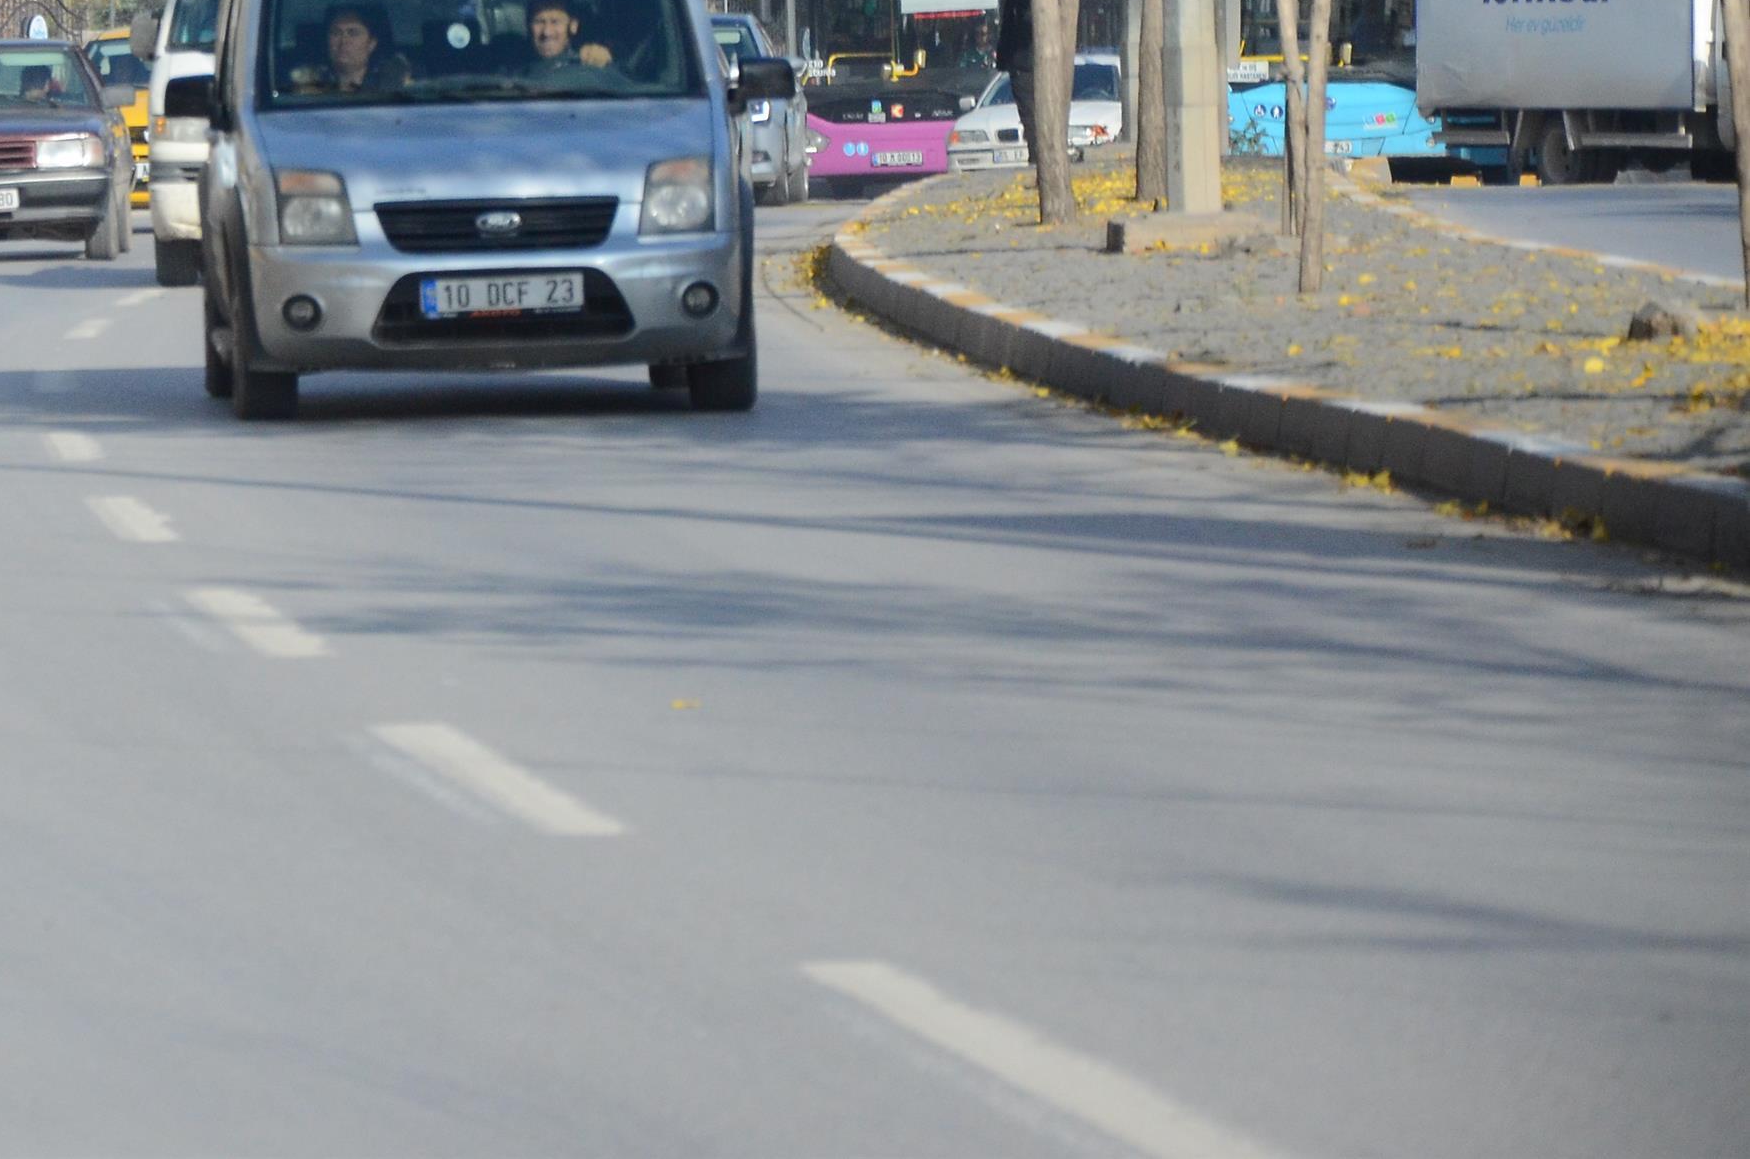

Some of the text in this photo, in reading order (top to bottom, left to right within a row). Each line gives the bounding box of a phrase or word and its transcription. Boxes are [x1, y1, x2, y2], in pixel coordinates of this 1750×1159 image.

[444, 279, 574, 308] 10 DCF 23
